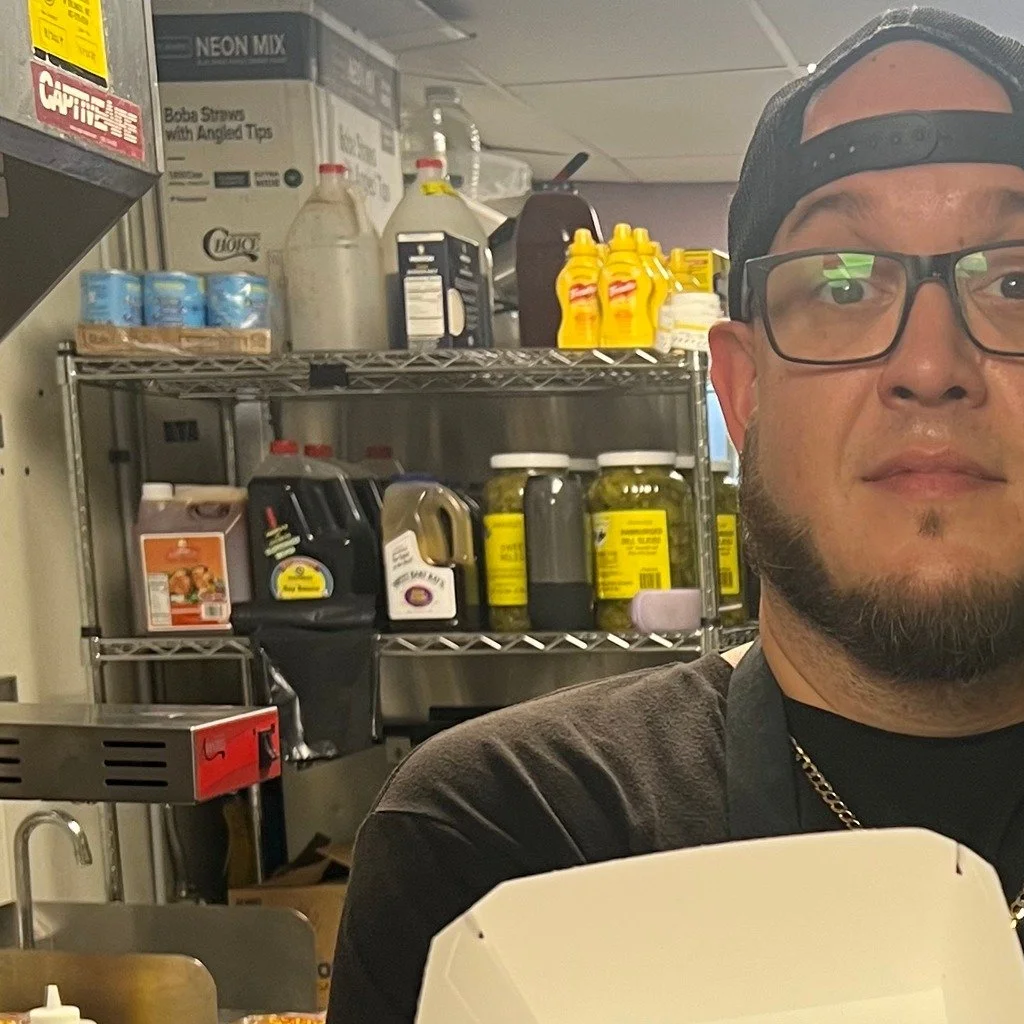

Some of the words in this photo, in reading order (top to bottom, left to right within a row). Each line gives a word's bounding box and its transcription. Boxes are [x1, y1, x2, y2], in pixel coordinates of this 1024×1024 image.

[195, 35, 249, 58] NEON
[252, 33, 287, 56] MIX
[163, 106, 199, 123] Boba
[201, 105, 246, 122] Straws
[165, 124, 194, 142] with
[197, 124, 244, 145] Angled
[245, 123, 274, 145] Tips
